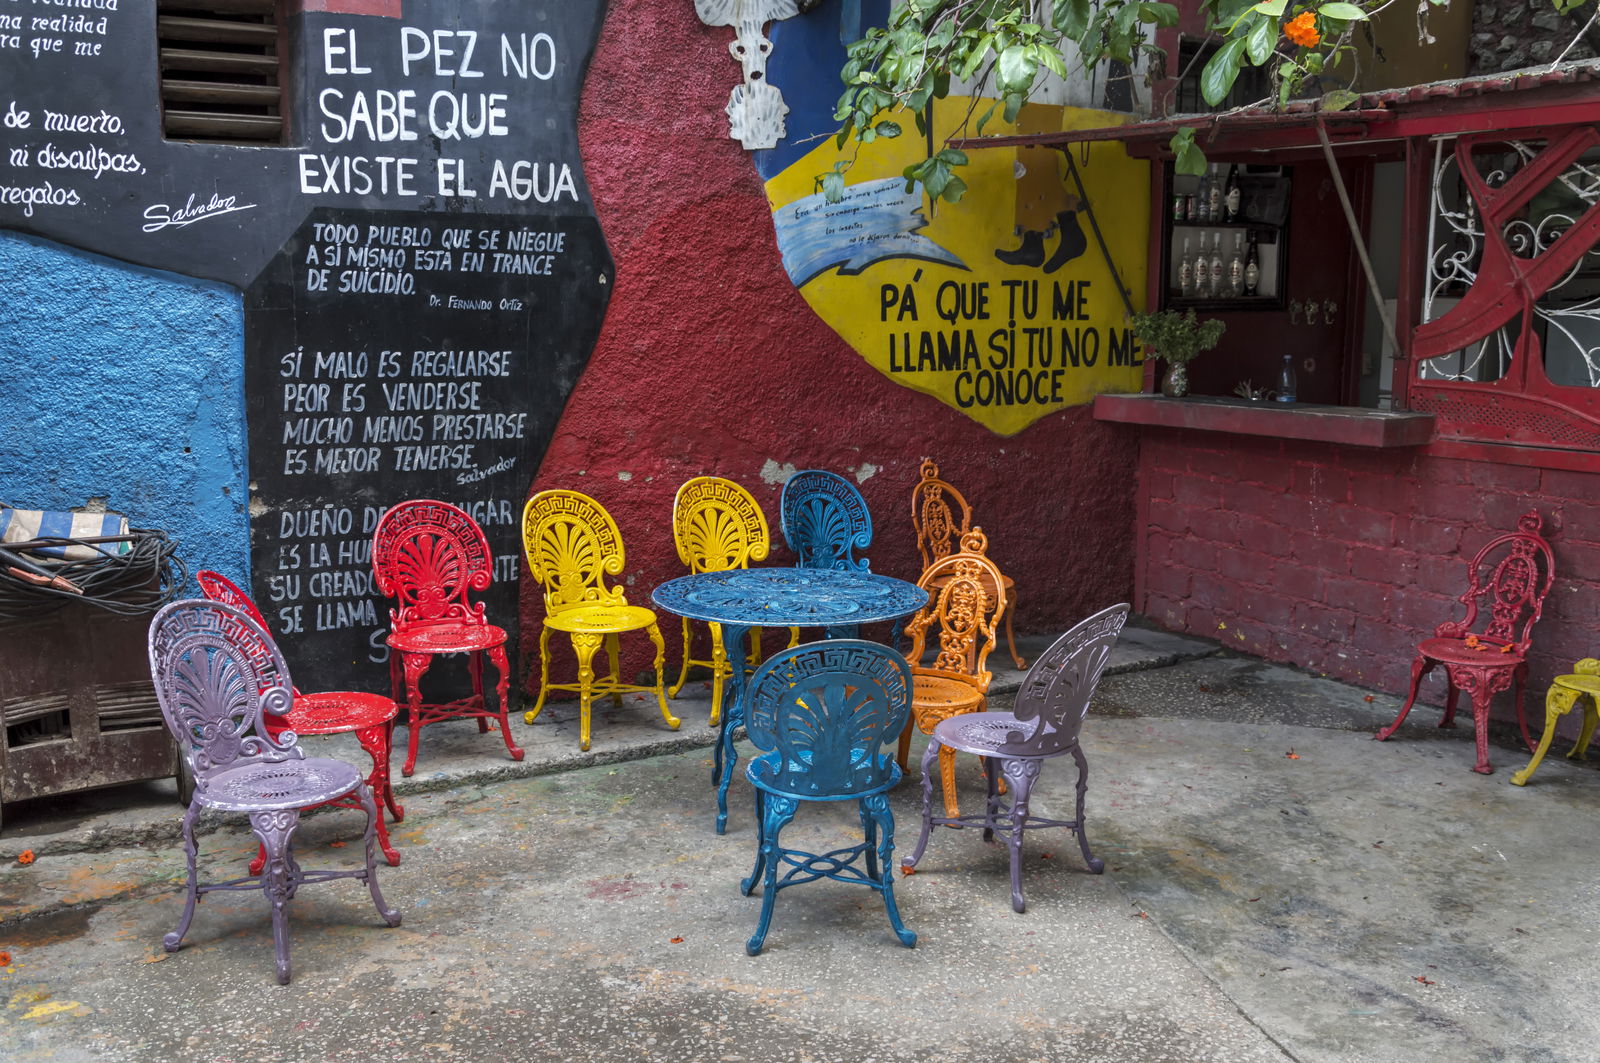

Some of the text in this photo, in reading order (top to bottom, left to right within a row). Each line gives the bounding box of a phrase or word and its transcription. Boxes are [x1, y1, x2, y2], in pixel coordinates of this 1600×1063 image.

[32, 14, 107, 35] realidad
[30, 37, 63, 59] que
[74, 41, 102, 56] me
[323, 27, 556, 80] EL PEZ NO
[4, 101, 125, 135] de muerto,
[319, 88, 509, 143] SABE QUE
[10, 142, 147, 179] ni disculpas,
[299, 154, 579, 203] EXISTE EL AGUA
[0, 181, 87, 217] regalos.
[313, 223, 359, 246] TODO
[367, 225, 432, 247] PUEBLO
[441, 228, 472, 250] QUE
[479, 231, 500, 250] SE
[306, 245, 317, 266] A
[414, 250, 452, 271] ESTA
[460, 252, 485, 272] EN
[493, 252, 556, 276] TRANCE
[307, 269, 329, 292] DE
[429, 295, 442, 307] Dr.
[449, 296, 492, 311] FERNANDO
[936, 280, 990, 325] QUE
[1002, 280, 1039, 321] TU
[1052, 280, 1091, 321] ME
[314, 351, 369, 379] MALO
[378, 350, 401, 378] ES
[411, 350, 512, 377] REGALARSE
[890, 329, 981, 372] LLAMA
[1022, 326, 1053, 368] TU
[1061, 327, 1100, 368] NO
[1108, 327, 1143, 367] ME
[283, 381, 482, 412] PEOR ES VENDERSE
[955, 371, 1064, 407] CONOCE
[282, 412, 528, 445] MUCHO MENOS PRESTARSE
[283, 444, 478, 475] ES MEJOR TENERSE.
[279, 503, 351, 539] DUEÑO
[448, 500, 514, 530] UGAR
[278, 544, 301, 570] ES
[309, 542, 331, 568] LA
[270, 574, 300, 602] SU
[279, 599, 379, 635] SE LLAMA
